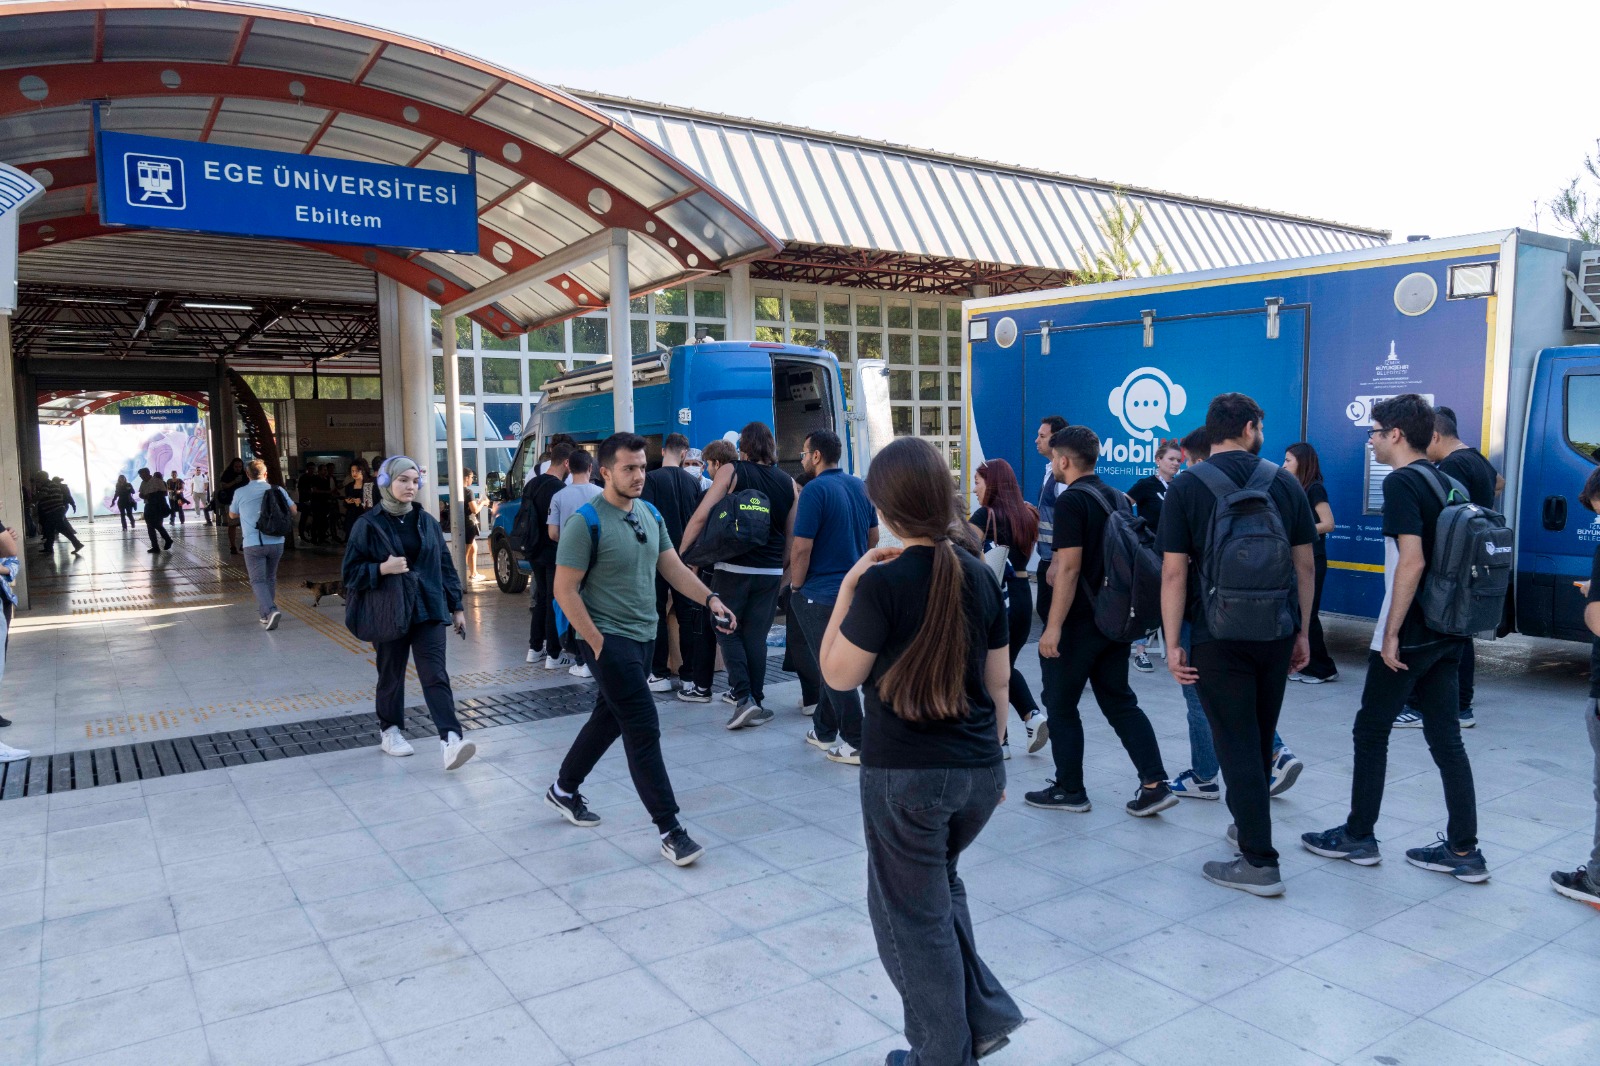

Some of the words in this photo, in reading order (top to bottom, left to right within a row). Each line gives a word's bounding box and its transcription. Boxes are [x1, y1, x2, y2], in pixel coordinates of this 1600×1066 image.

[203, 160, 264, 185] EGE
[273, 165, 457, 205] ÜNİVERSİTESİ
[295, 205, 382, 228] Ebiltem
